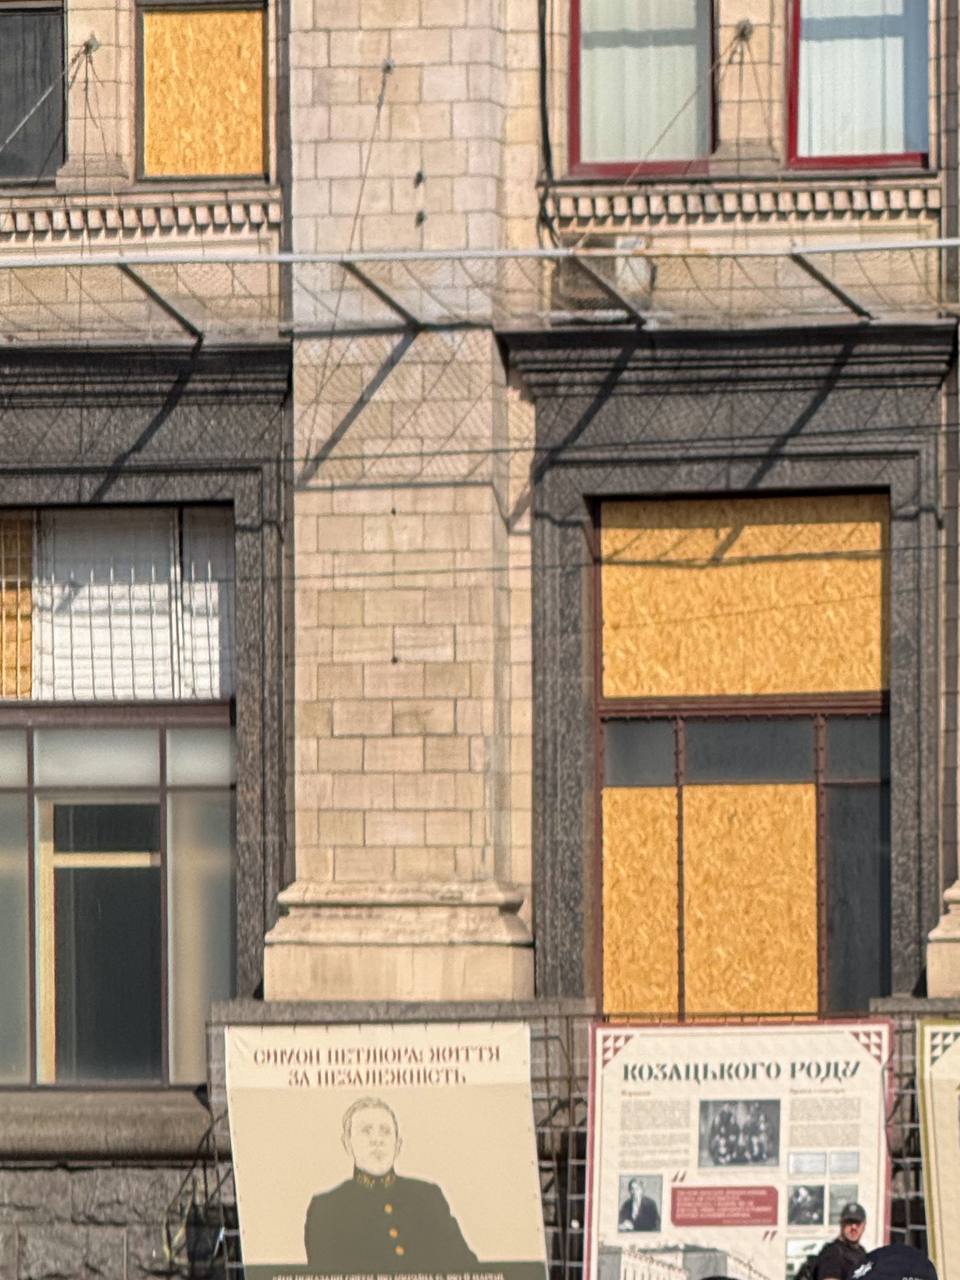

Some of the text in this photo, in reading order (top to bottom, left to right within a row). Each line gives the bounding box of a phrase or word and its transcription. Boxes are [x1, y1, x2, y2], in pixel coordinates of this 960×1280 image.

[253, 1048, 320, 1065] СИМОН
[430, 1045, 500, 1063] ЖИТТЯ
[288, 1066, 467, 1087] ЗА НЕЗАЛЕЖНІСТЬ
[623, 1061, 861, 1085] КОЗАЦЬКОГО РОДУ
